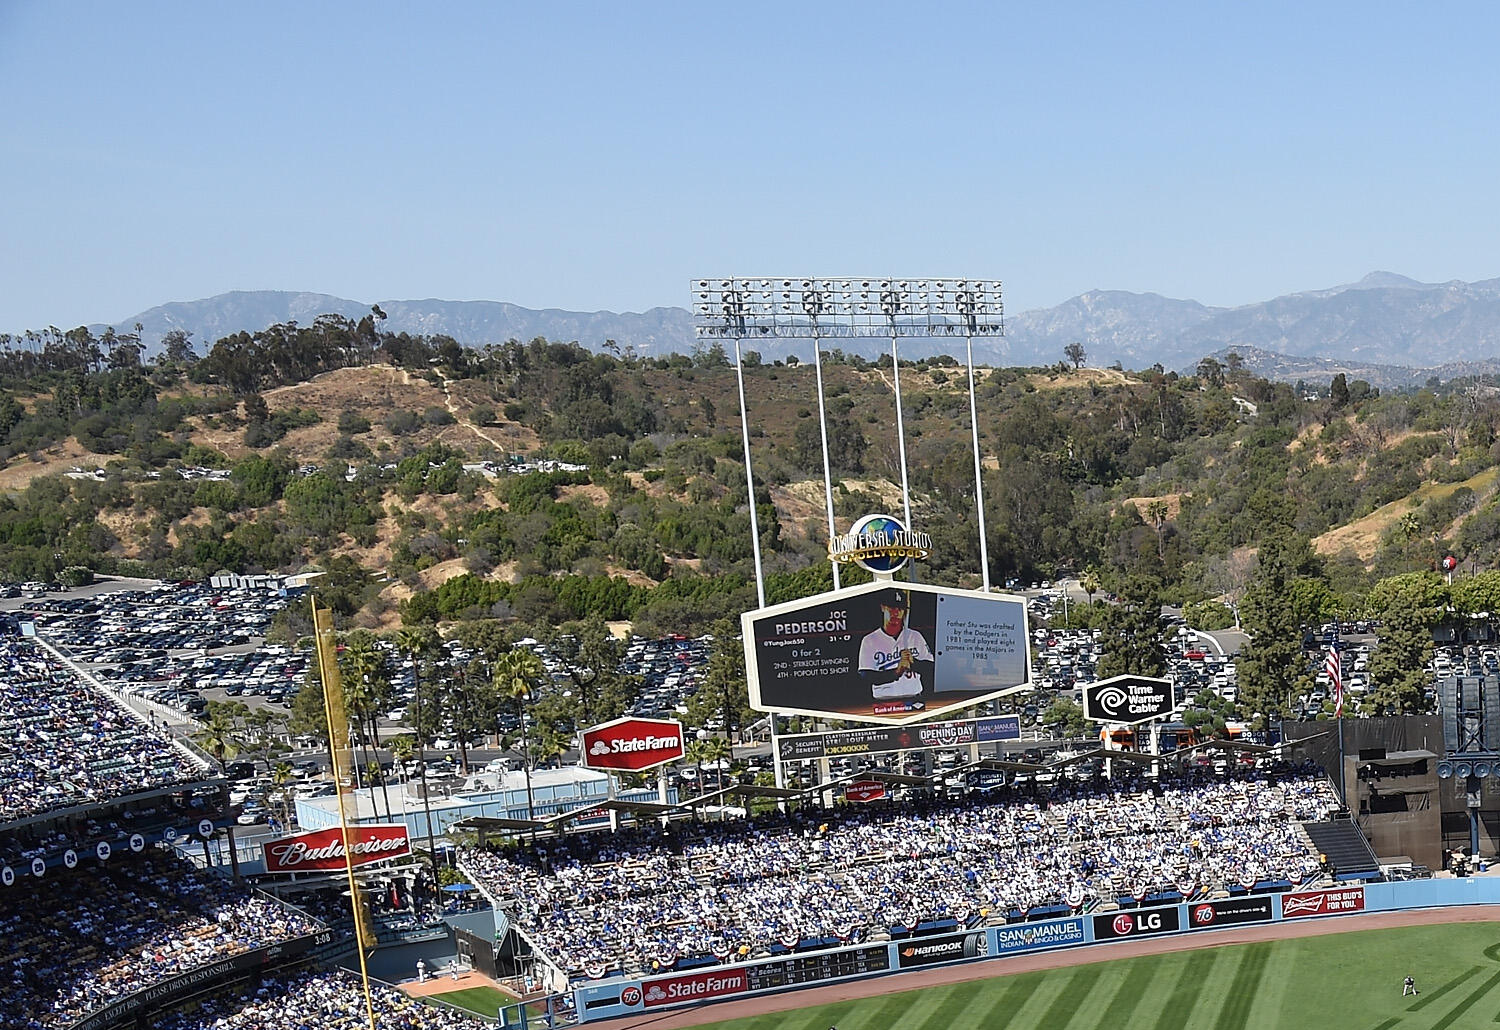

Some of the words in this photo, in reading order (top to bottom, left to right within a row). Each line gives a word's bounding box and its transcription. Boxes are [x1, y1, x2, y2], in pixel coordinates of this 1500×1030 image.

[849, 549, 922, 562] HOLLYWOOD
[829, 611, 847, 620] JOC
[775, 620, 847, 635] PEDERSON
[946, 620, 966, 628] Father
[992, 623, 1015, 631] drafted
[974, 629, 1000, 638] Dodgers
[963, 636, 976, 644] and
[977, 637, 998, 646] played
[800, 649, 812, 657] for
[814, 648, 821, 656] 2
[829, 667, 849, 675] SHORT
[1127, 686, 1153, 695] Time
[1128, 694, 1164, 704] Warner
[875, 706, 888, 714] Bank
[892, 704, 912, 712] America
[1128, 703, 1160, 713] Cable
[978, 725, 992, 733] SAN
[994, 722, 1018, 731] MANUEL
[867, 734, 889, 742] METER
[919, 728, 957, 741] OPENING
[957, 726, 974, 738] DAY
[795, 740, 822, 748] SECURITY
[201, 824, 211, 833] 53
[132, 838, 142, 848] 39
[99, 846, 109, 856] 32
[271, 834, 407, 866] Budweiser
[67, 854, 76, 864] 24
[1327, 893, 1341, 901] THIS
[1342, 891, 1362, 900] BUD'S
[1327, 902, 1340, 910] FOR
[1341, 900, 1356, 909] YOU.
[1197, 907, 1212, 922] 76
[1137, 913, 1161, 930] LG
[1000, 930, 1024, 942] SAN
[1032, 922, 1081, 938] MANUEL
[314, 933, 331, 945] 3:08
[1000, 940, 1024, 949] INDIAN
[1034, 935, 1054, 945] BINGO
[1059, 931, 1082, 942] CASINO
[144, 983, 168, 1000] PLEASE
[168, 977, 190, 993] DRINK
[625, 988, 639, 1002] 76
